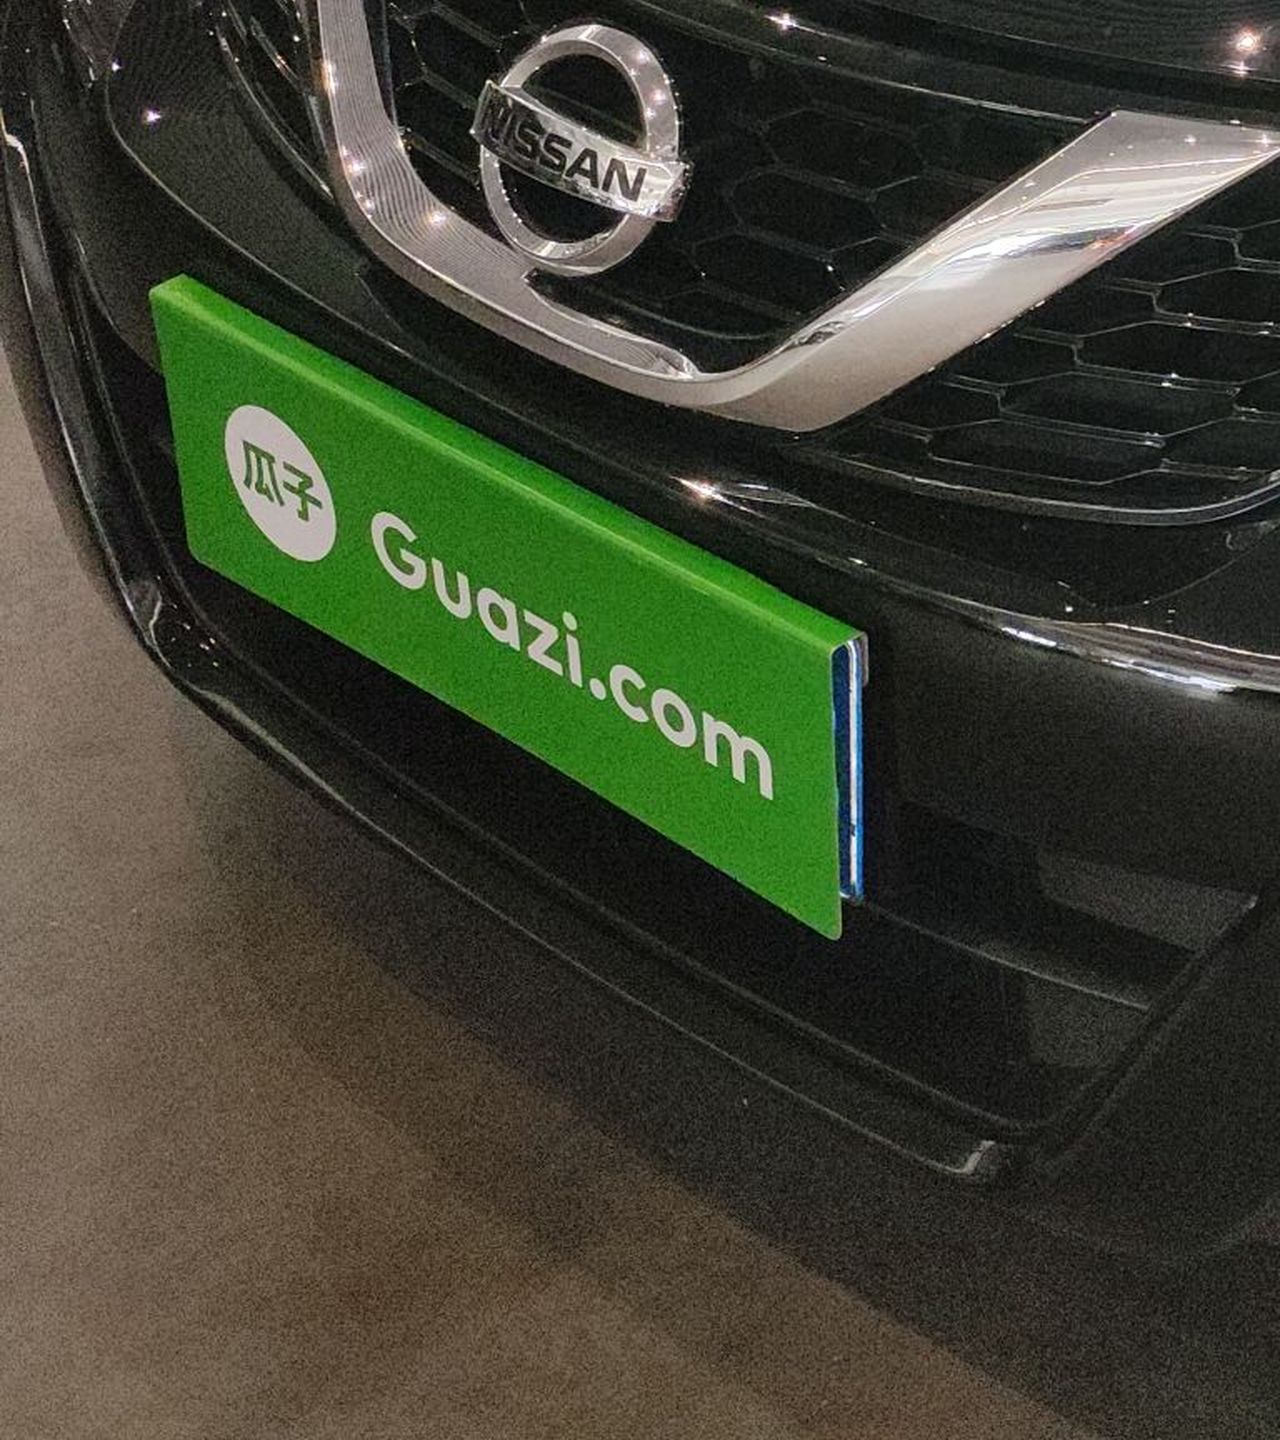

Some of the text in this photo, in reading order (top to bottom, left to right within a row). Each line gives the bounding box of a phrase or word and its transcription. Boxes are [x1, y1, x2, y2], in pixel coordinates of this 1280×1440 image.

[484, 93, 647, 202] NISSAN
[242, 440, 323, 522] 瓜子
[371, 512, 774, 800] Guazi.com
